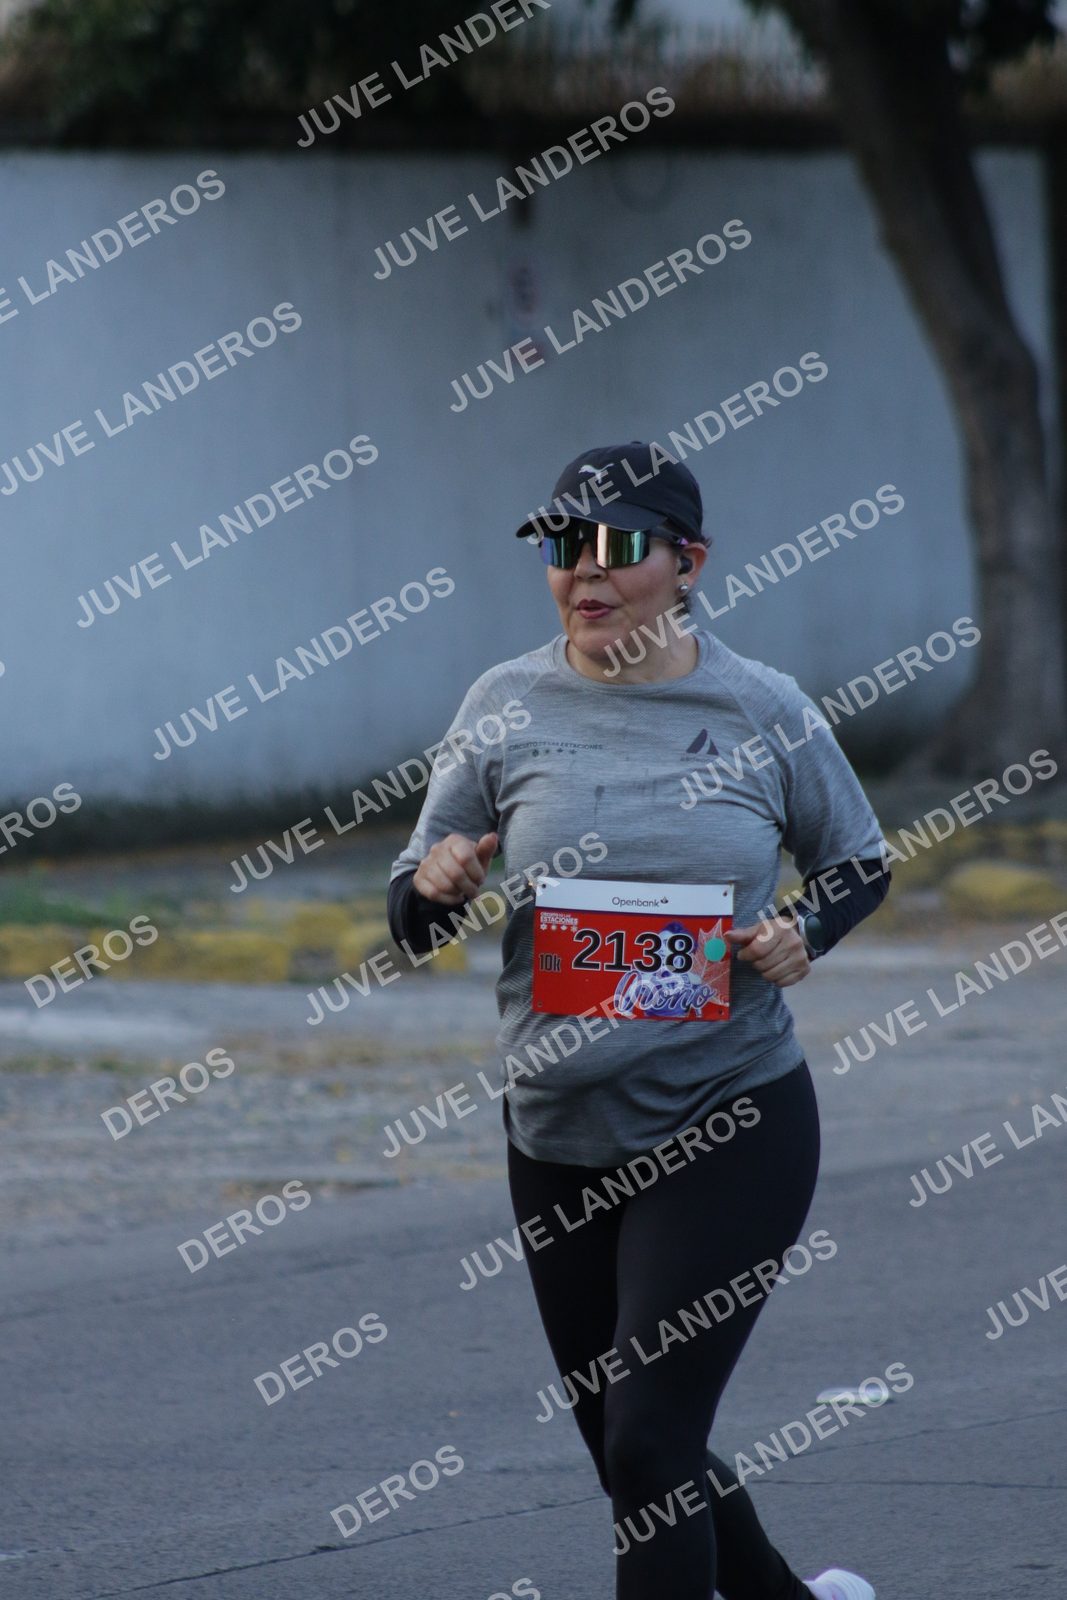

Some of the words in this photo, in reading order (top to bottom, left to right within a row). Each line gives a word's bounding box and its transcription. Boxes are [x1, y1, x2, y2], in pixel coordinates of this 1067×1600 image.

[611, 896, 660, 908] Openbank
[540, 916, 579, 926] ESTACIONES
[572, 928, 694, 974] 2138
